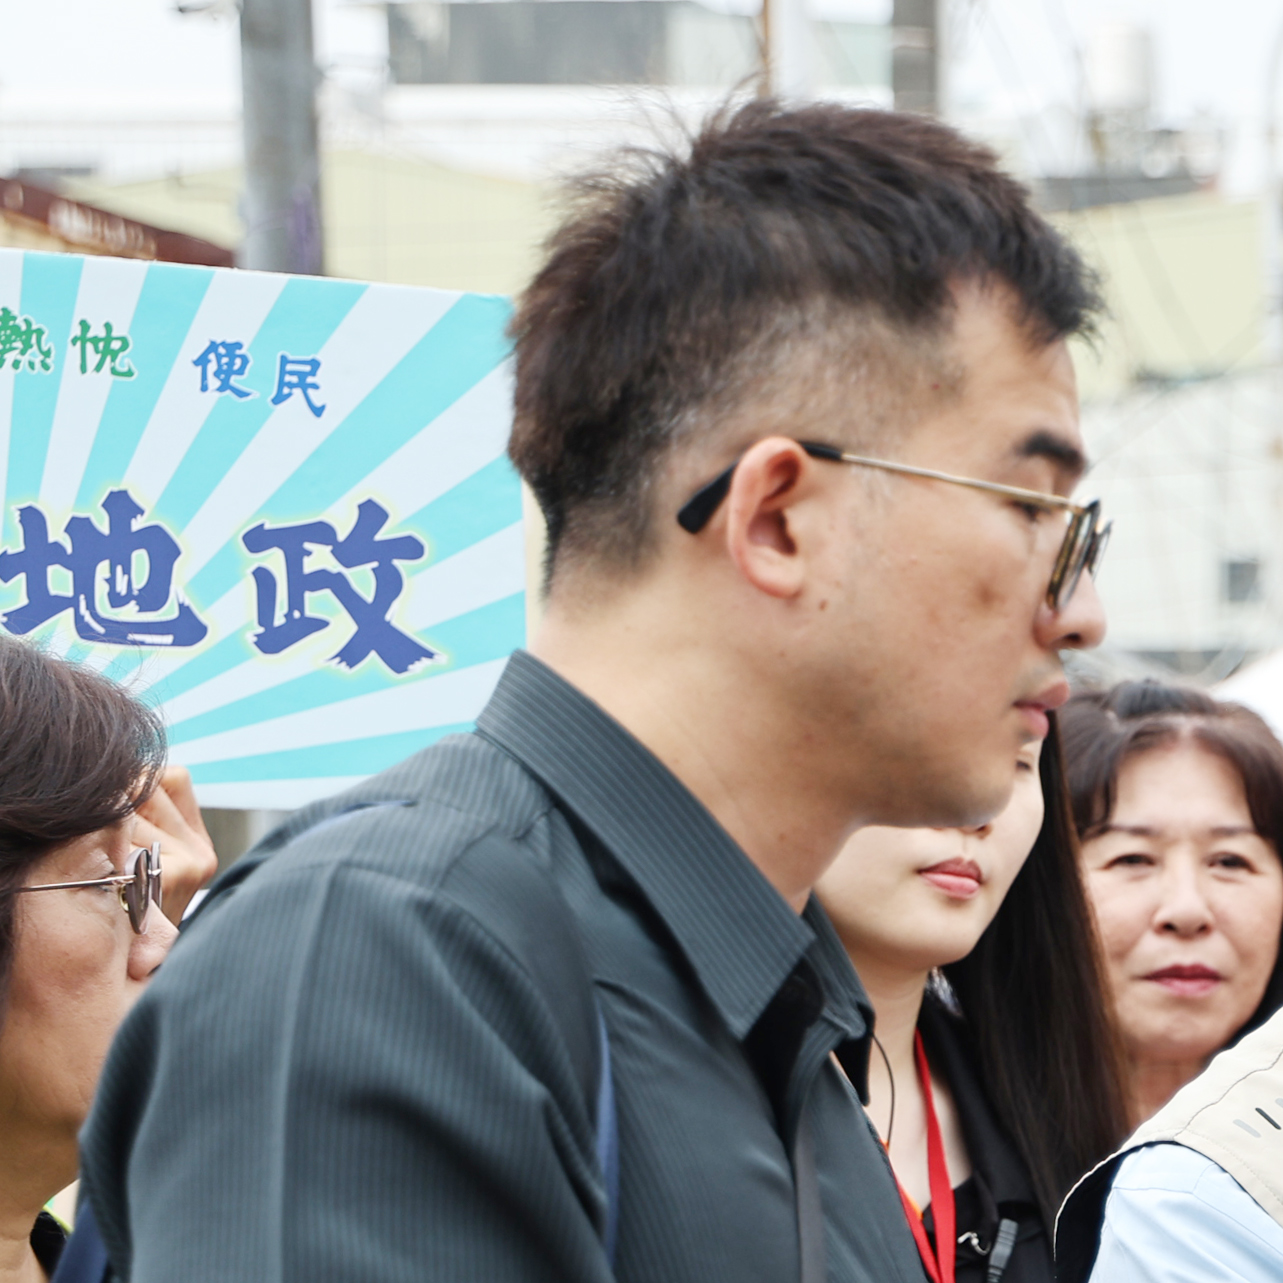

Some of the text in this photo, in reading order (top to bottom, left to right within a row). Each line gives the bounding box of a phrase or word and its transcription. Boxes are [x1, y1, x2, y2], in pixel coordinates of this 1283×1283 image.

[0, 306, 327, 419] 熱忱 便民
[0, 488, 443, 676] 地政
